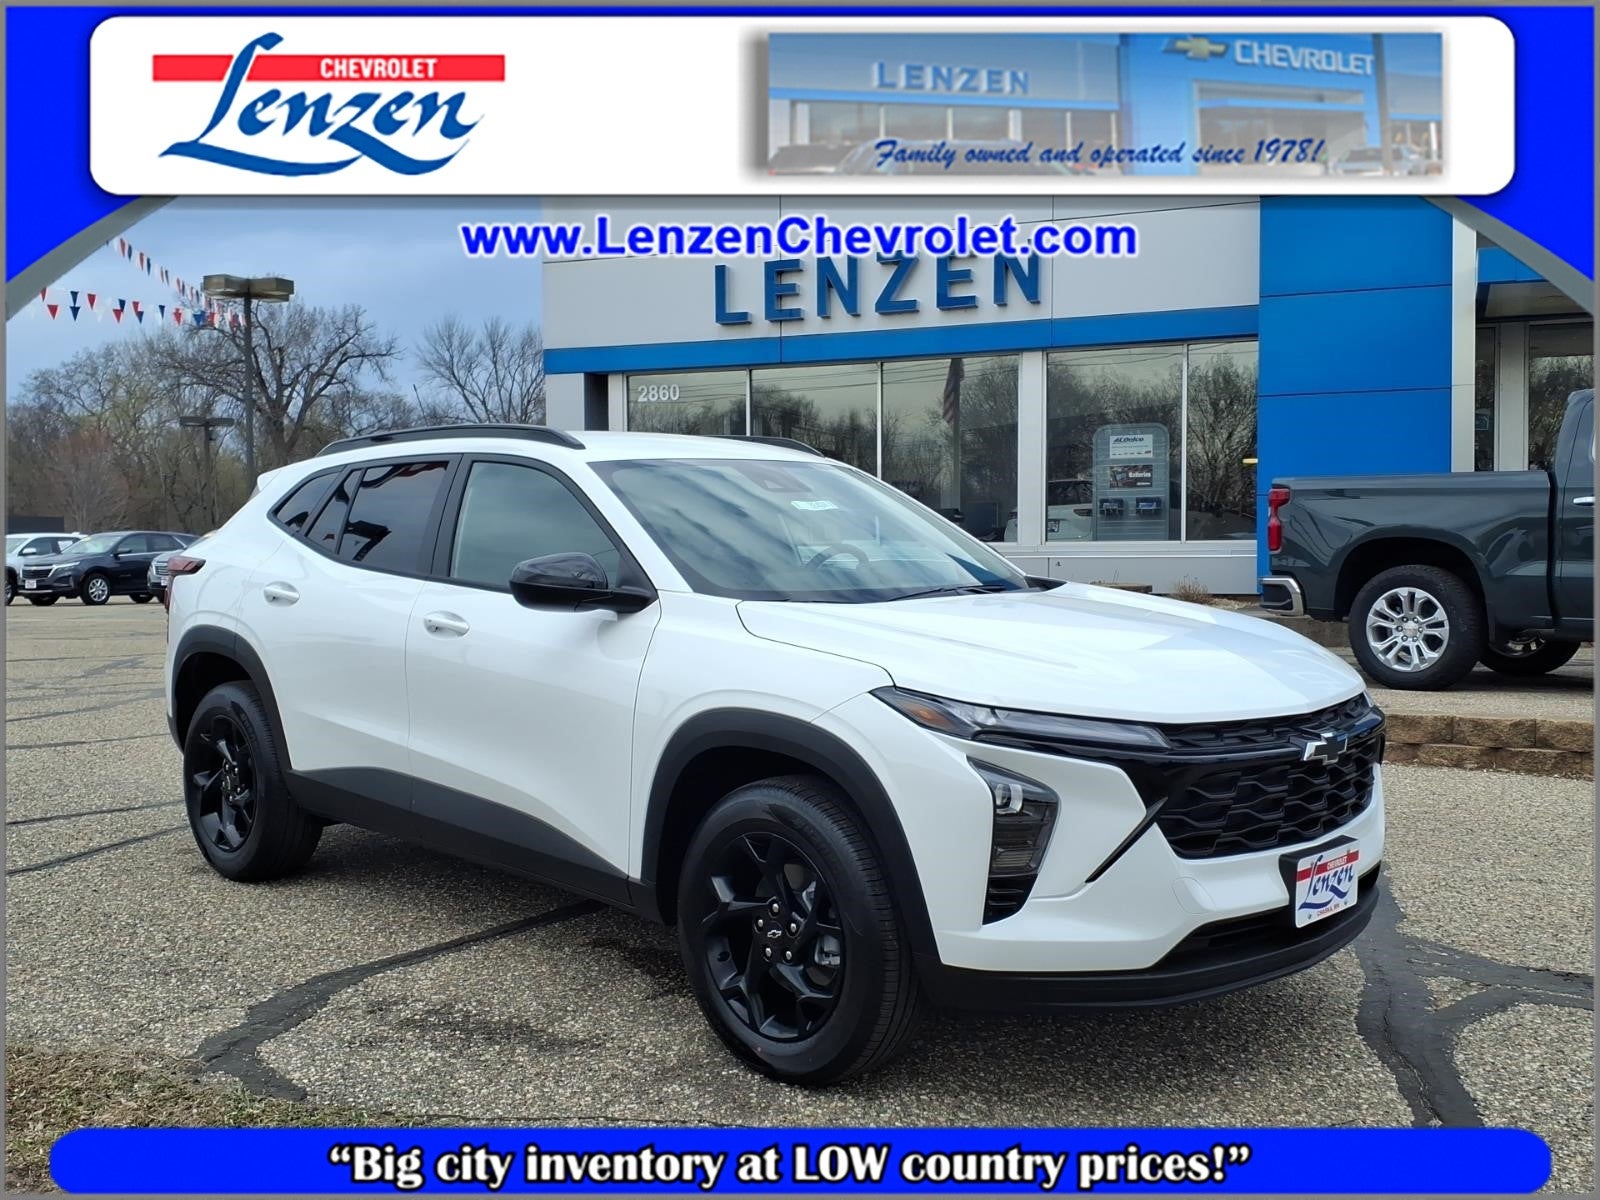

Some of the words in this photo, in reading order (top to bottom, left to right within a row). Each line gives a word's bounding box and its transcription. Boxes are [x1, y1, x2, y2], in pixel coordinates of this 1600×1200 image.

[714, 240, 1042, 326] LENZEN
[637, 384, 680, 402] 2860
[1298, 854, 1355, 910] Lenzen
